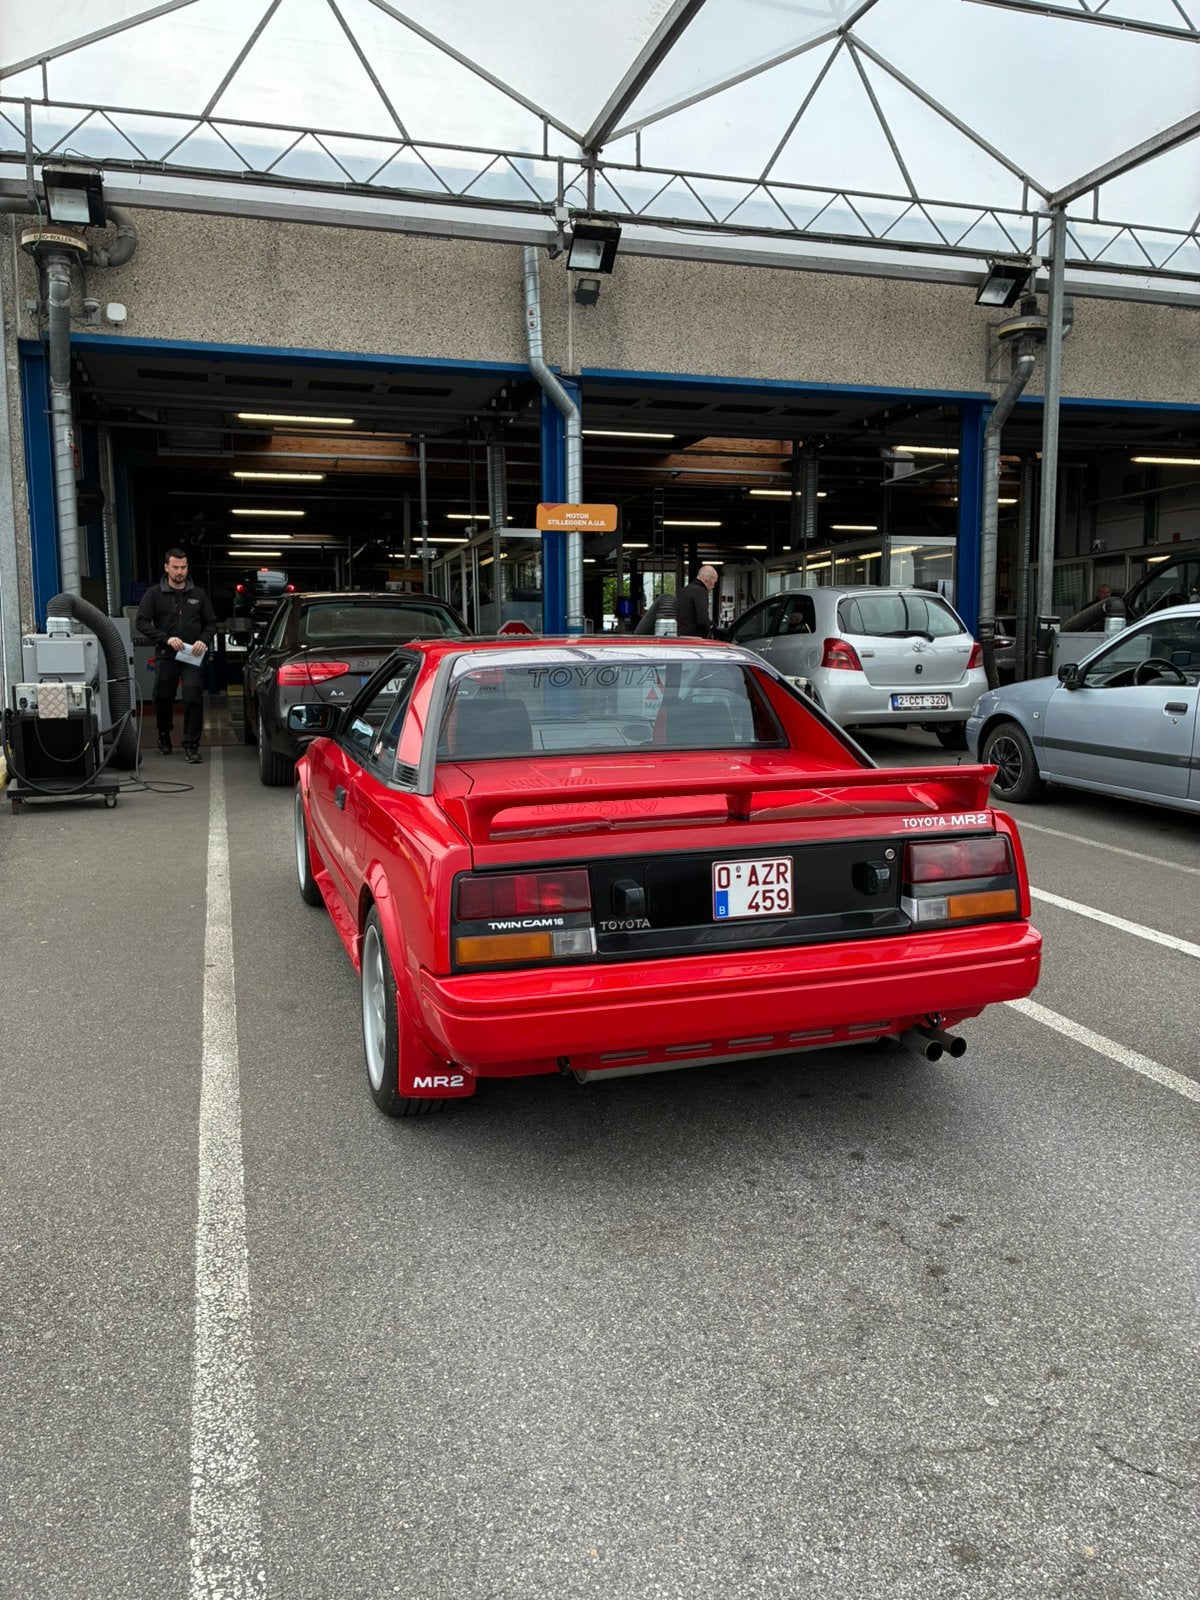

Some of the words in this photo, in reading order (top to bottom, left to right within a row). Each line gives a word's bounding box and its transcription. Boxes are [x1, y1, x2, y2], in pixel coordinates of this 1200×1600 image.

[528, 666, 660, 688] TOYOTA
[902, 816, 946, 828] TOYOTA
[951, 814, 987, 825] MR2
[748, 888, 789, 912] 459
[719, 906, 726, 915] B
[488, 920, 520, 930] TWIN
[522, 918, 552, 928] CAM
[553, 917, 564, 926] 16
[600, 918, 651, 931] TOYOTA
[413, 1075, 464, 1088] MR2
